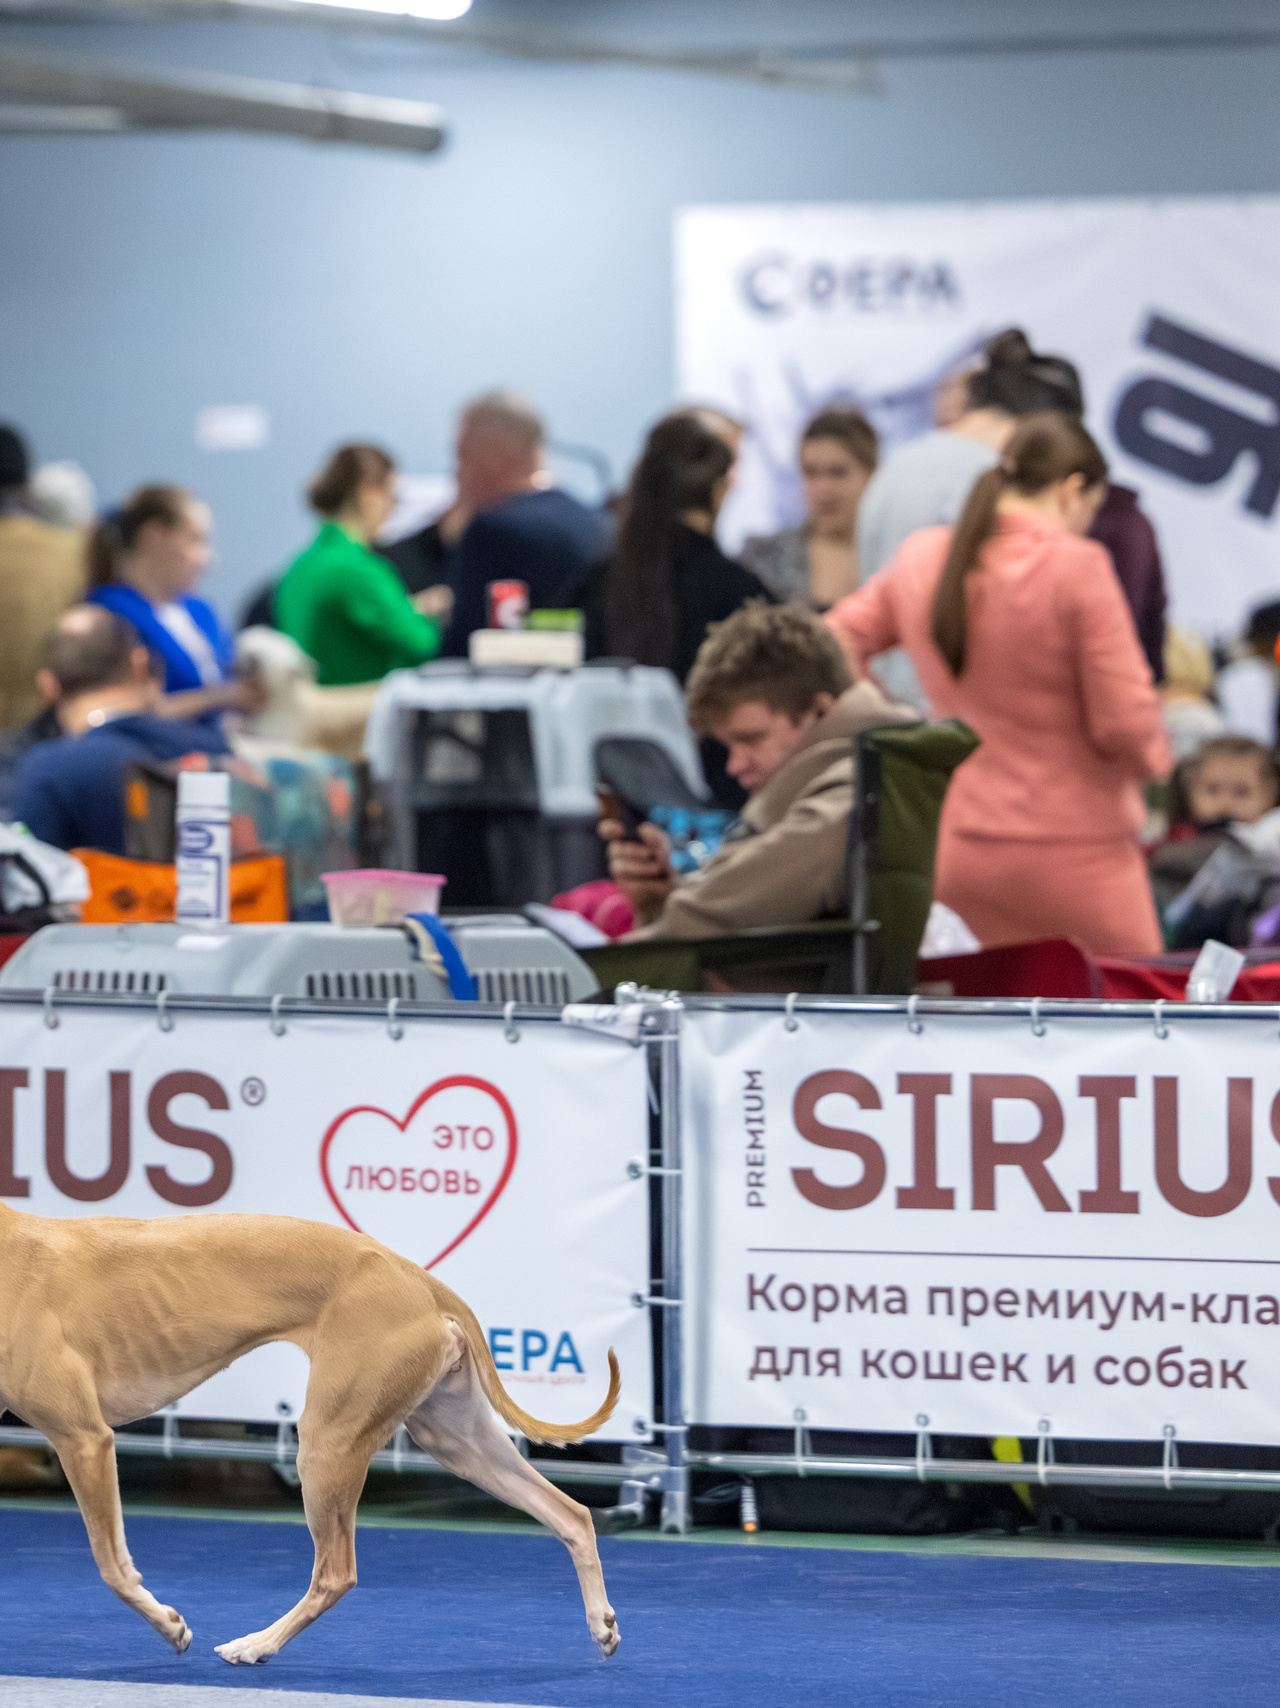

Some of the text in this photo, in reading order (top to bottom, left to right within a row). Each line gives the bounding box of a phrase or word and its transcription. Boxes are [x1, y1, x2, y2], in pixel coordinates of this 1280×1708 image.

[433, 1125, 495, 1151] ЭТО
[743, 1069, 766, 1208] PREMIUM
[789, 1068, 1280, 1218] SIRIU
[344, 1166, 482, 1195] ЛЮБОВЬ
[747, 1273, 909, 1322] Корма
[748, 1345, 1249, 1391] для кошек и собак
